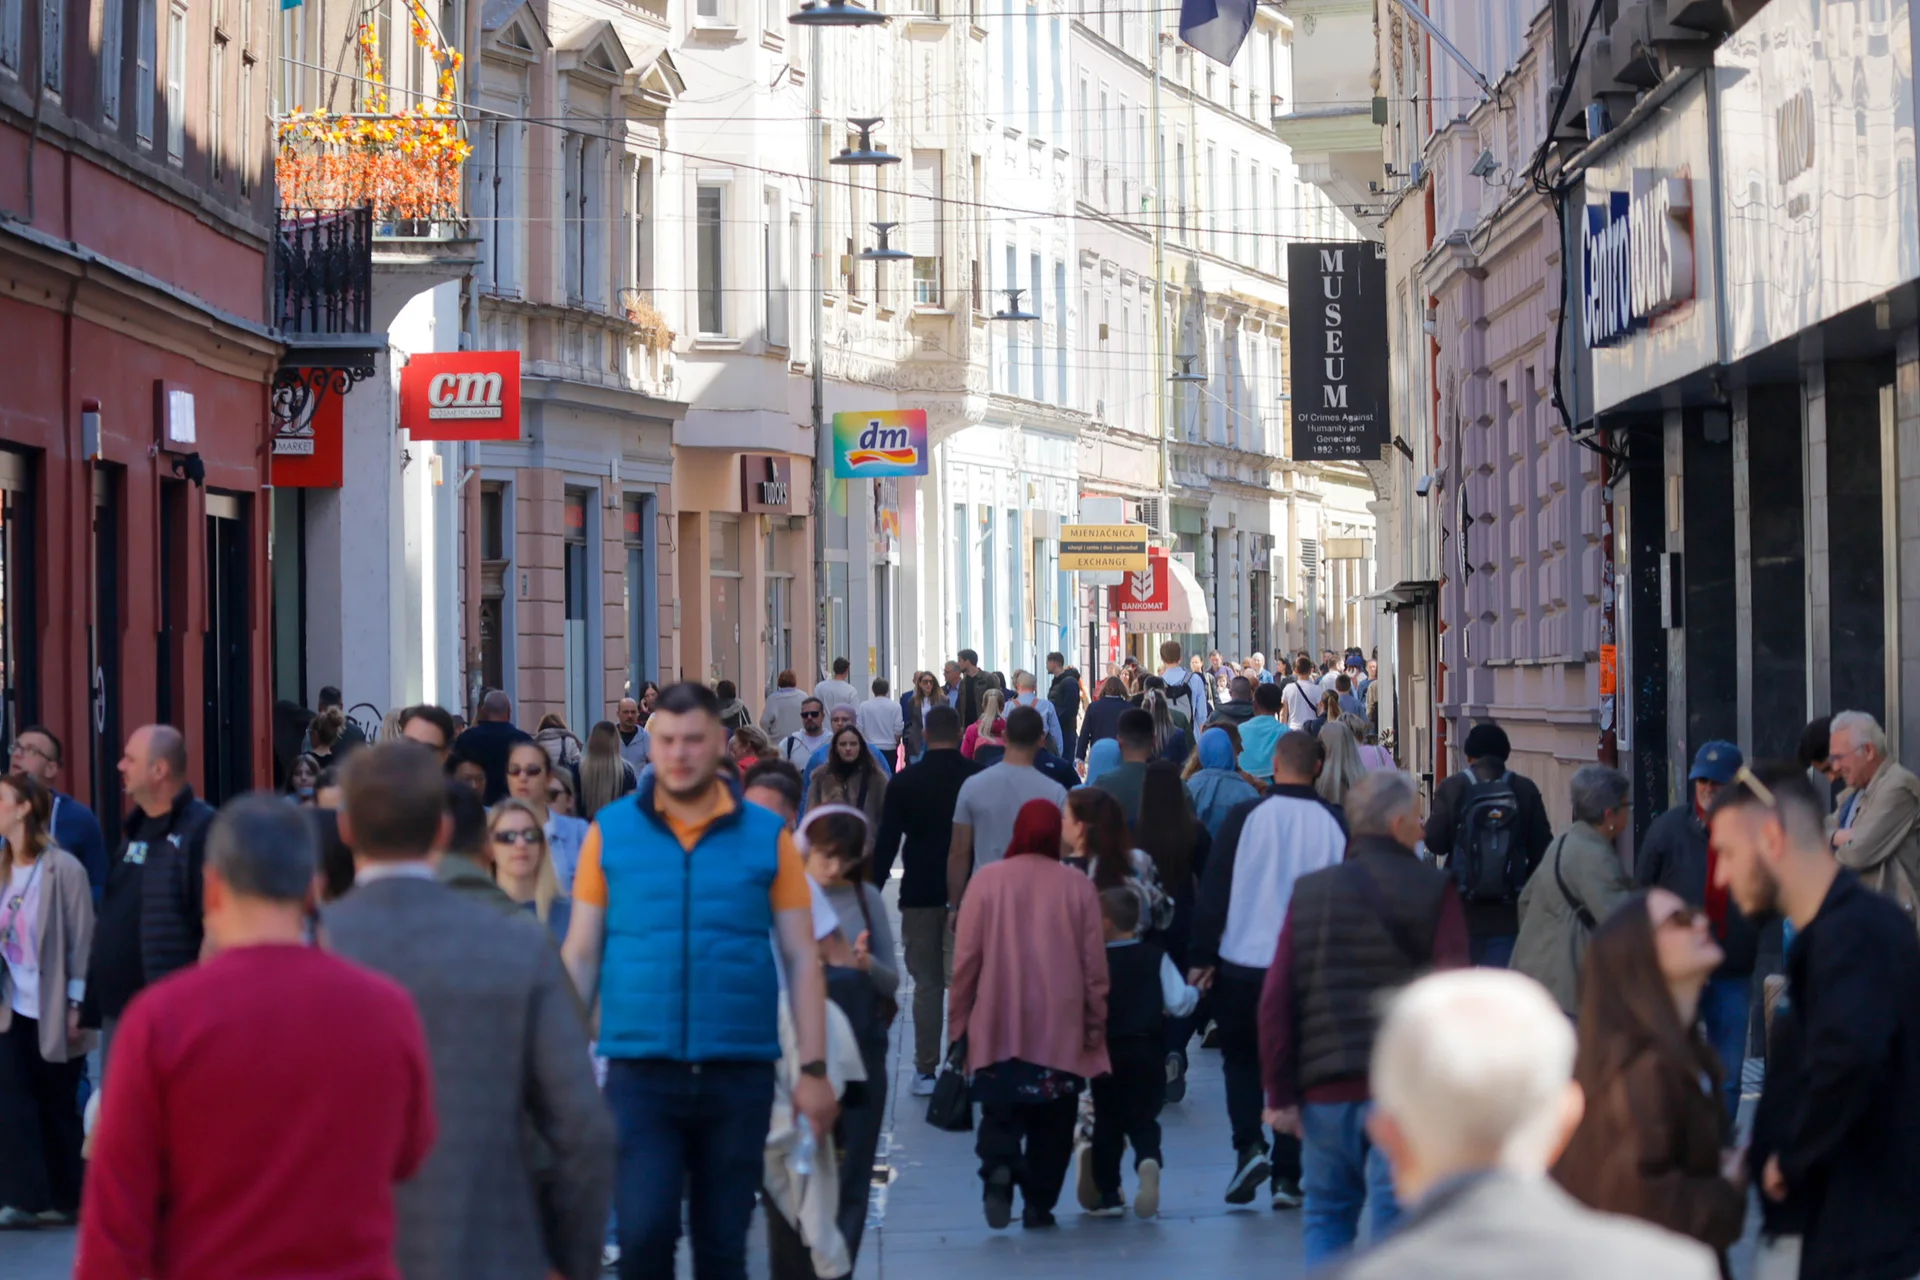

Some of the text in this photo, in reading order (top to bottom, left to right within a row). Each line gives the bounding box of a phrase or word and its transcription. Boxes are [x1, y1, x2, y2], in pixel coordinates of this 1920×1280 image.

[1319, 249, 1348, 408] MUSEUM
[428, 372, 502, 407] cm
[430, 408, 500, 417] COSMETIC MARKET
[1298, 413, 1374, 423] Of Crimes Against
[1307, 424, 1365, 433] Humanity and
[859, 420, 908, 450] dm
[1316, 435, 1357, 443] Genocide
[277, 442, 313, 452] MARKET
[1313, 445, 1333, 454] 1992
[1341, 445, 1361, 454] 1995
[1070, 528, 1135, 538] MJENJAČNICA
[1078, 557, 1128, 566] EXCHANGE
[1121, 602, 1164, 610] BANKOMAT
